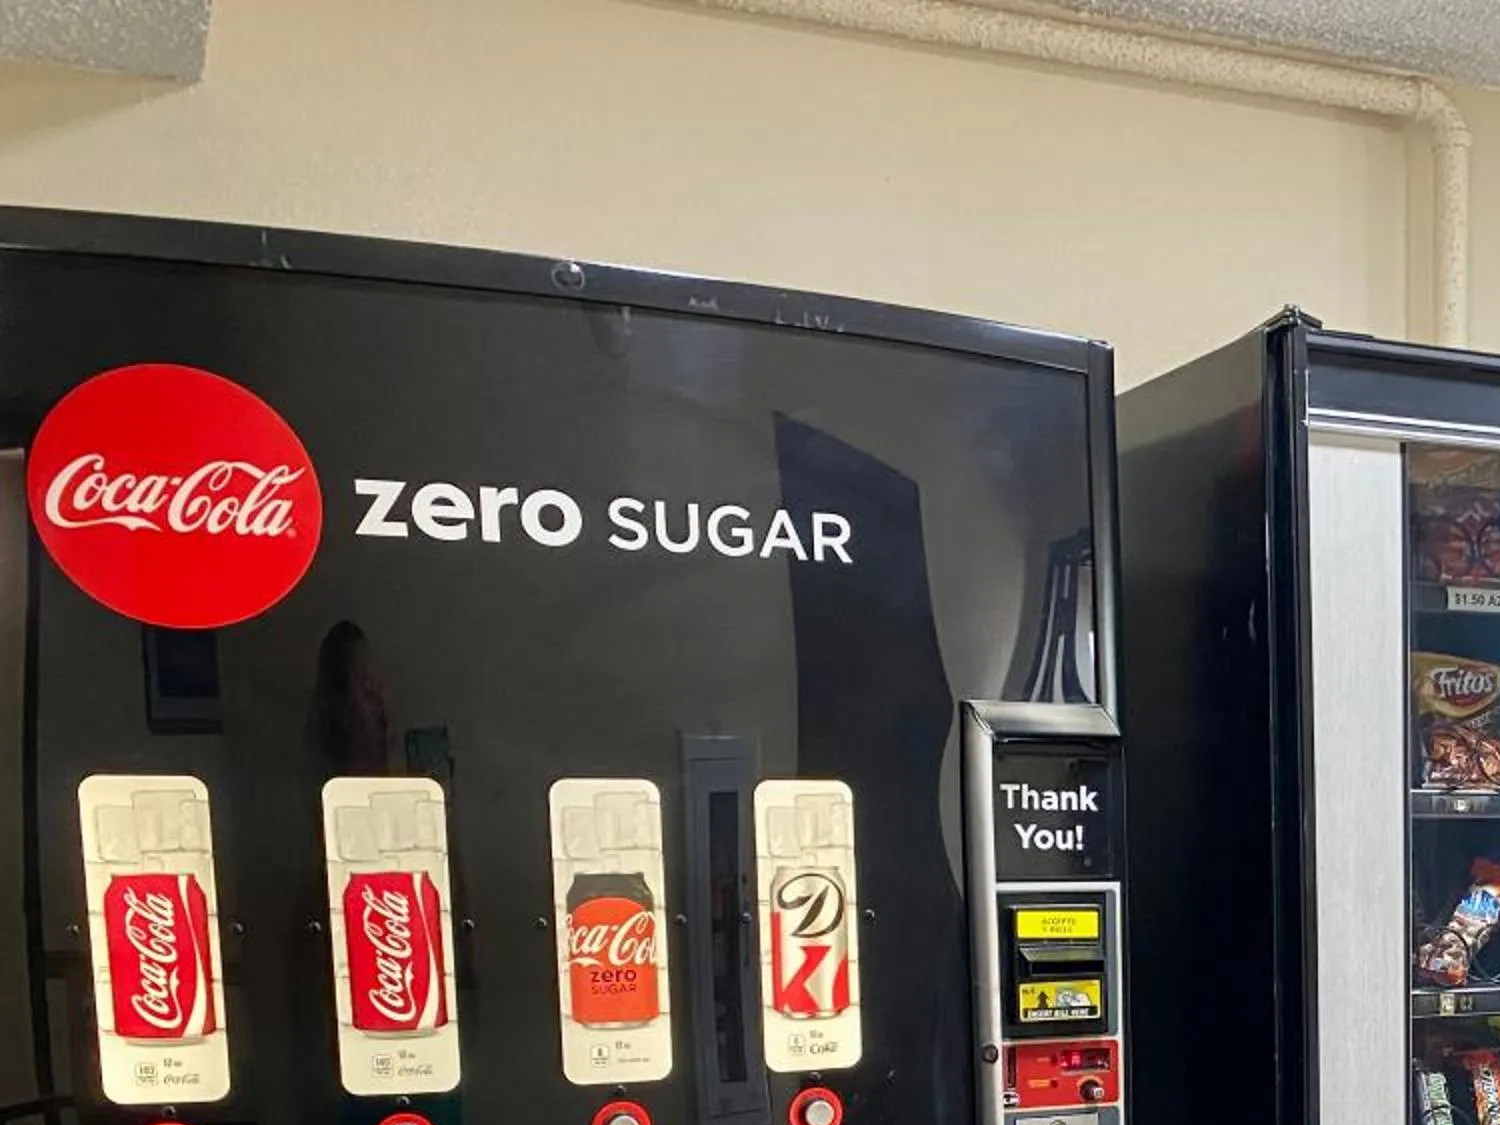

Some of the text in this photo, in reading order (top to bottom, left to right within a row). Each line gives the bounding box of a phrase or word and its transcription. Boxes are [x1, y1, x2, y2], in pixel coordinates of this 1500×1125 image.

[45, 452, 302, 537] Coca-Cola
[355, 478, 853, 564] zero SUGAR
[1000, 782, 1099, 812] Thank
[1014, 823, 1084, 852] You!
[124, 886, 183, 1029] Coca-Cola
[361, 883, 417, 1023] Coca-Cola
[591, 968, 637, 983] zero
[591, 983, 637, 996] SUGAR
